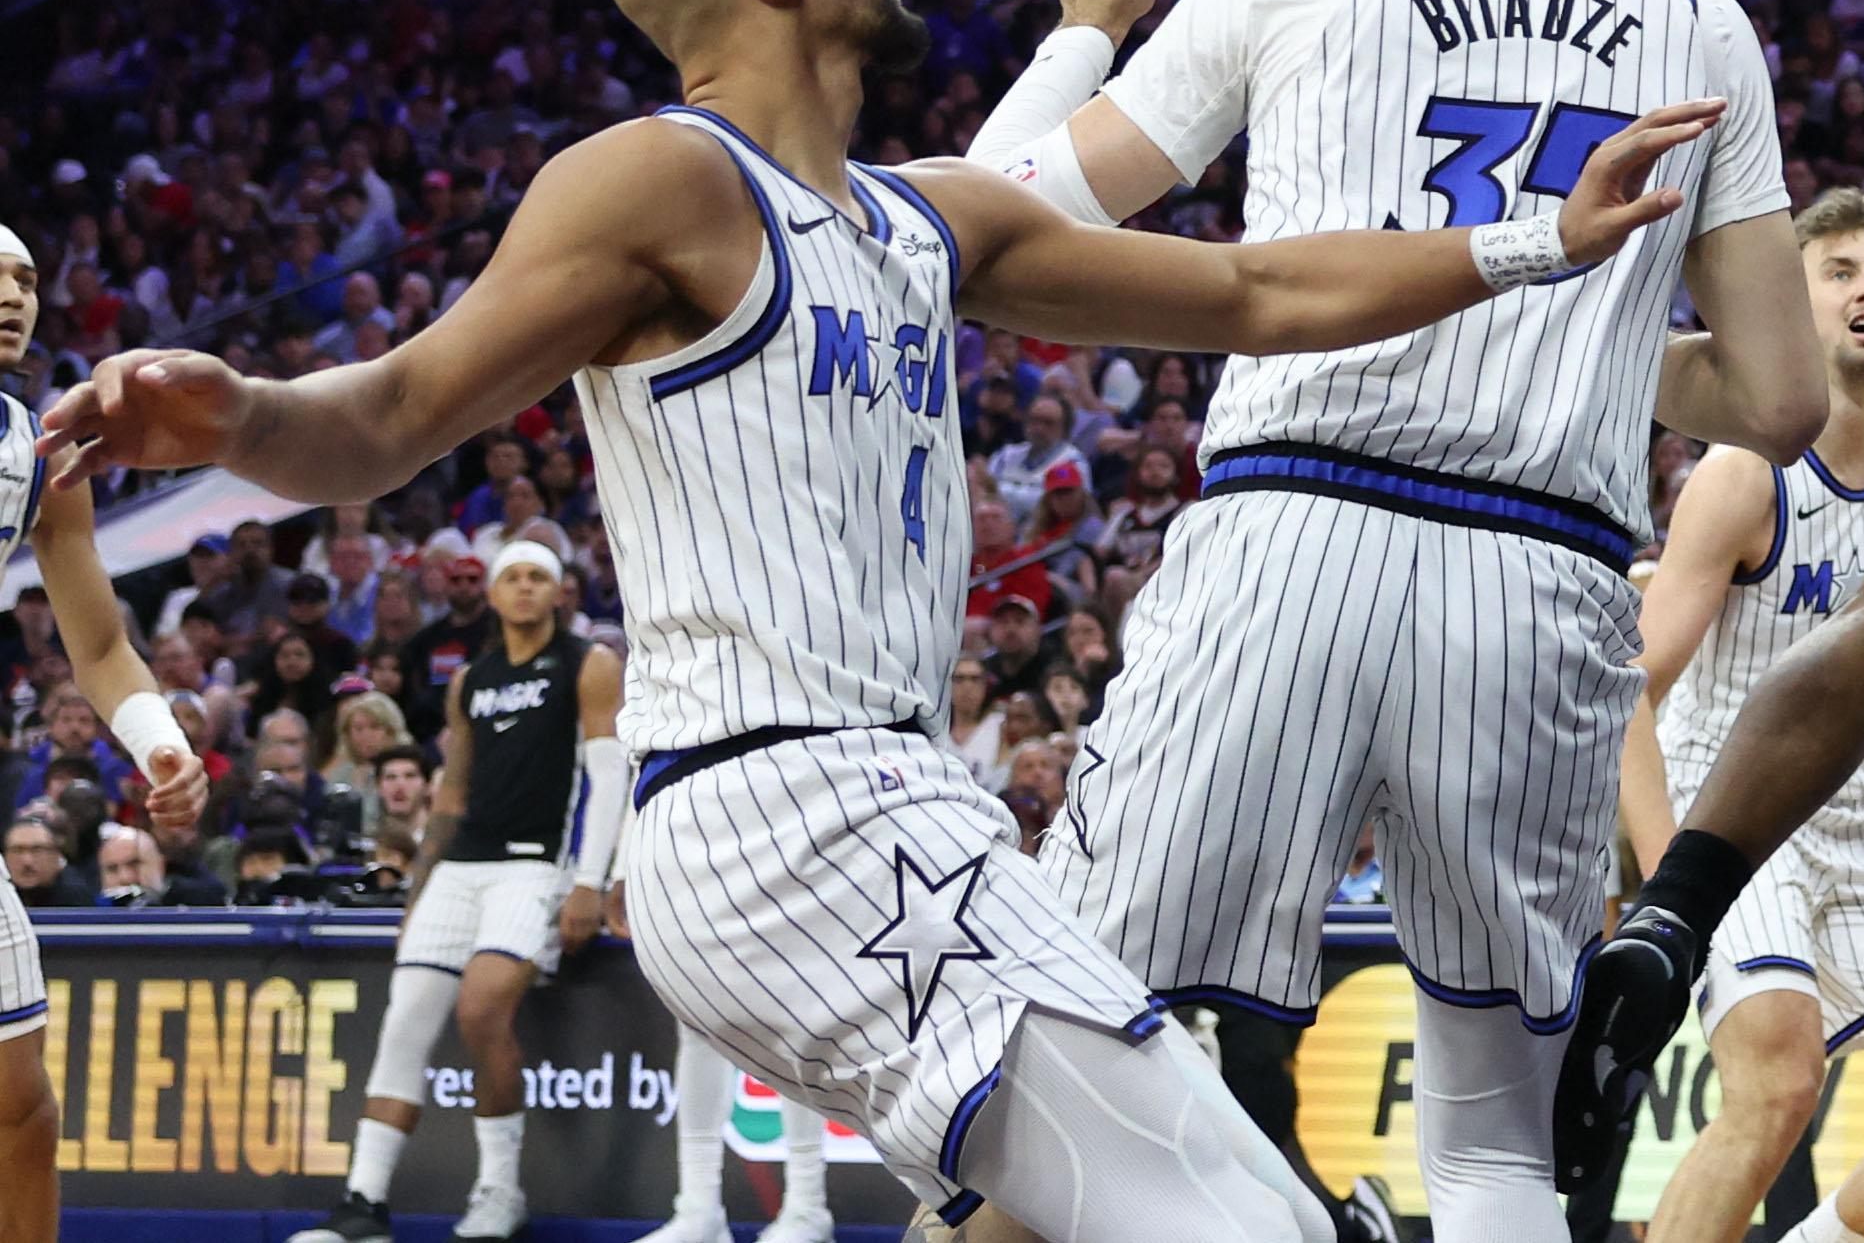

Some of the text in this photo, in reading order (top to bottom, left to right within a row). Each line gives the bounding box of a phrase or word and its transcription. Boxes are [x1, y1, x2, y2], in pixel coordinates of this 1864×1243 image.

[898, 233, 942, 257] Disney
[901, 445, 928, 567] 4
[628, 1051, 680, 1127] by
